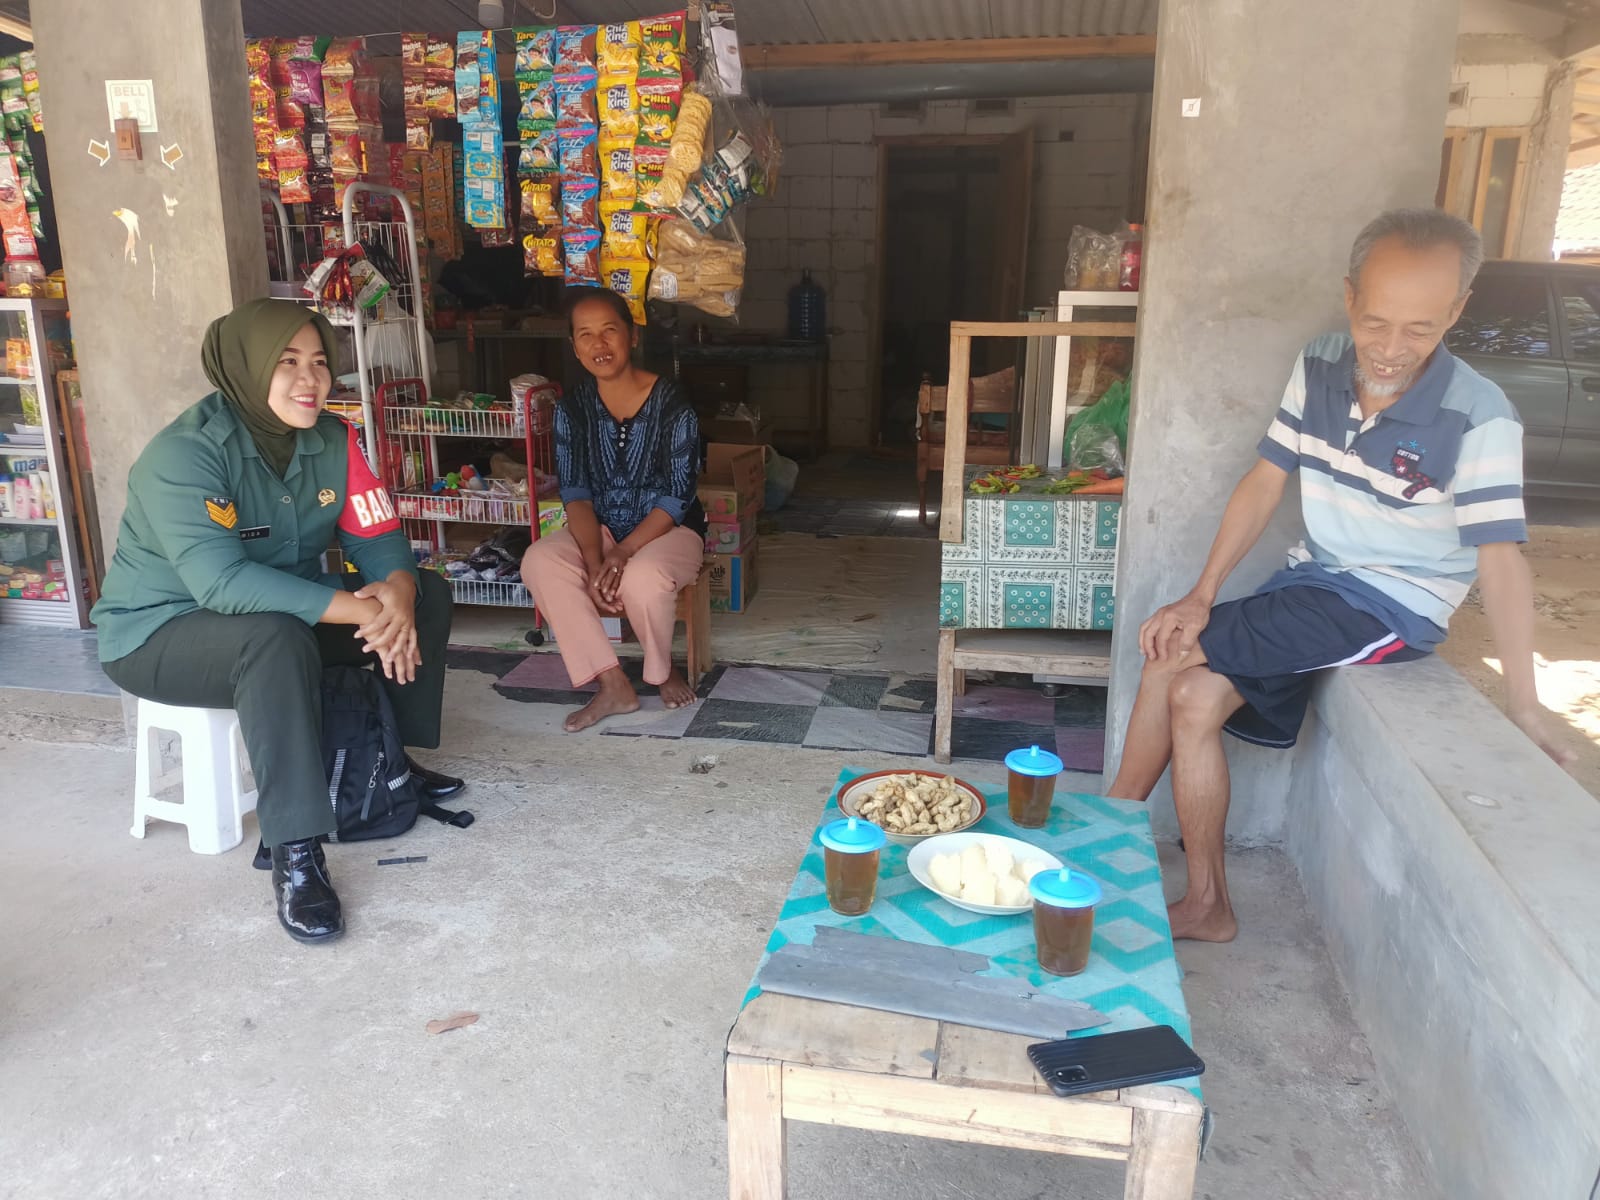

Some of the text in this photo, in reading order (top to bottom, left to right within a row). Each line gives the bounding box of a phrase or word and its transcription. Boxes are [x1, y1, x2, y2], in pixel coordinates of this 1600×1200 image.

[606, 24, 628, 33] Chiz
[642, 24, 672, 35] CHIKI
[516, 32, 536, 41] Taro
[606, 32, 628, 42] King
[518, 81, 538, 90] Taro
[114, 86, 146, 97] BELL
[607, 88, 629, 97] Chiz
[607, 97, 630, 109] King
[641, 94, 670, 106] CHIKI
[521, 129, 540, 138] Taro
[611, 151, 634, 160] Chiz
[611, 160, 634, 171] King
[638, 163, 664, 174] CHIK
[611, 212, 633, 222] Chiz
[610, 221, 633, 233] King
[523, 234, 557, 250] CHITATO
[610, 271, 633, 281] Chiz
[610, 281, 632, 293] King
